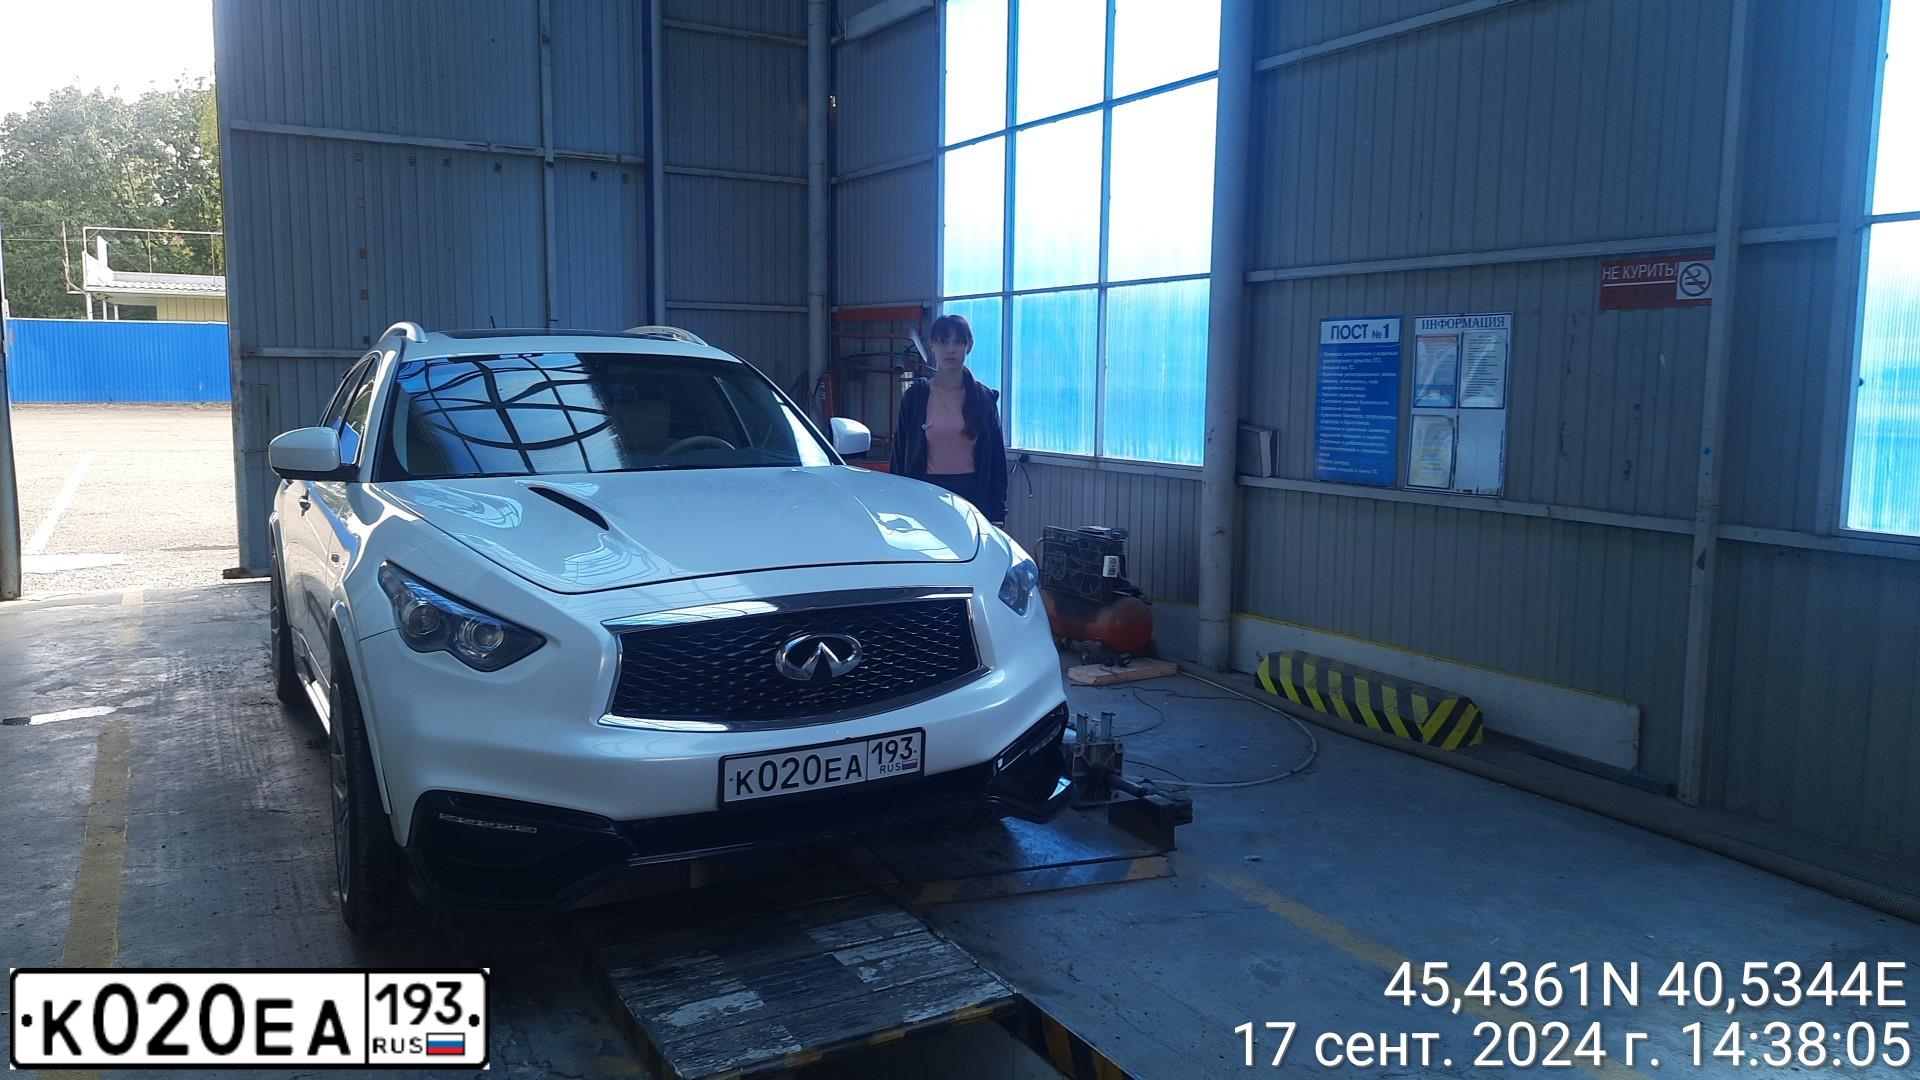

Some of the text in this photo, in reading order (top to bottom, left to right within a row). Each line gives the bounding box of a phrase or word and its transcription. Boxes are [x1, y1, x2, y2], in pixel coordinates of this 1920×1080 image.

[1602, 262, 1678, 280] НЕ КУРИТЬ!
[1422, 316, 1505, 330] ИНФОРМАЦИЯ
[1330, 324, 1369, 340] ПОСТ
[871, 736, 913, 765] 193
[879, 762, 901, 774] RUS
